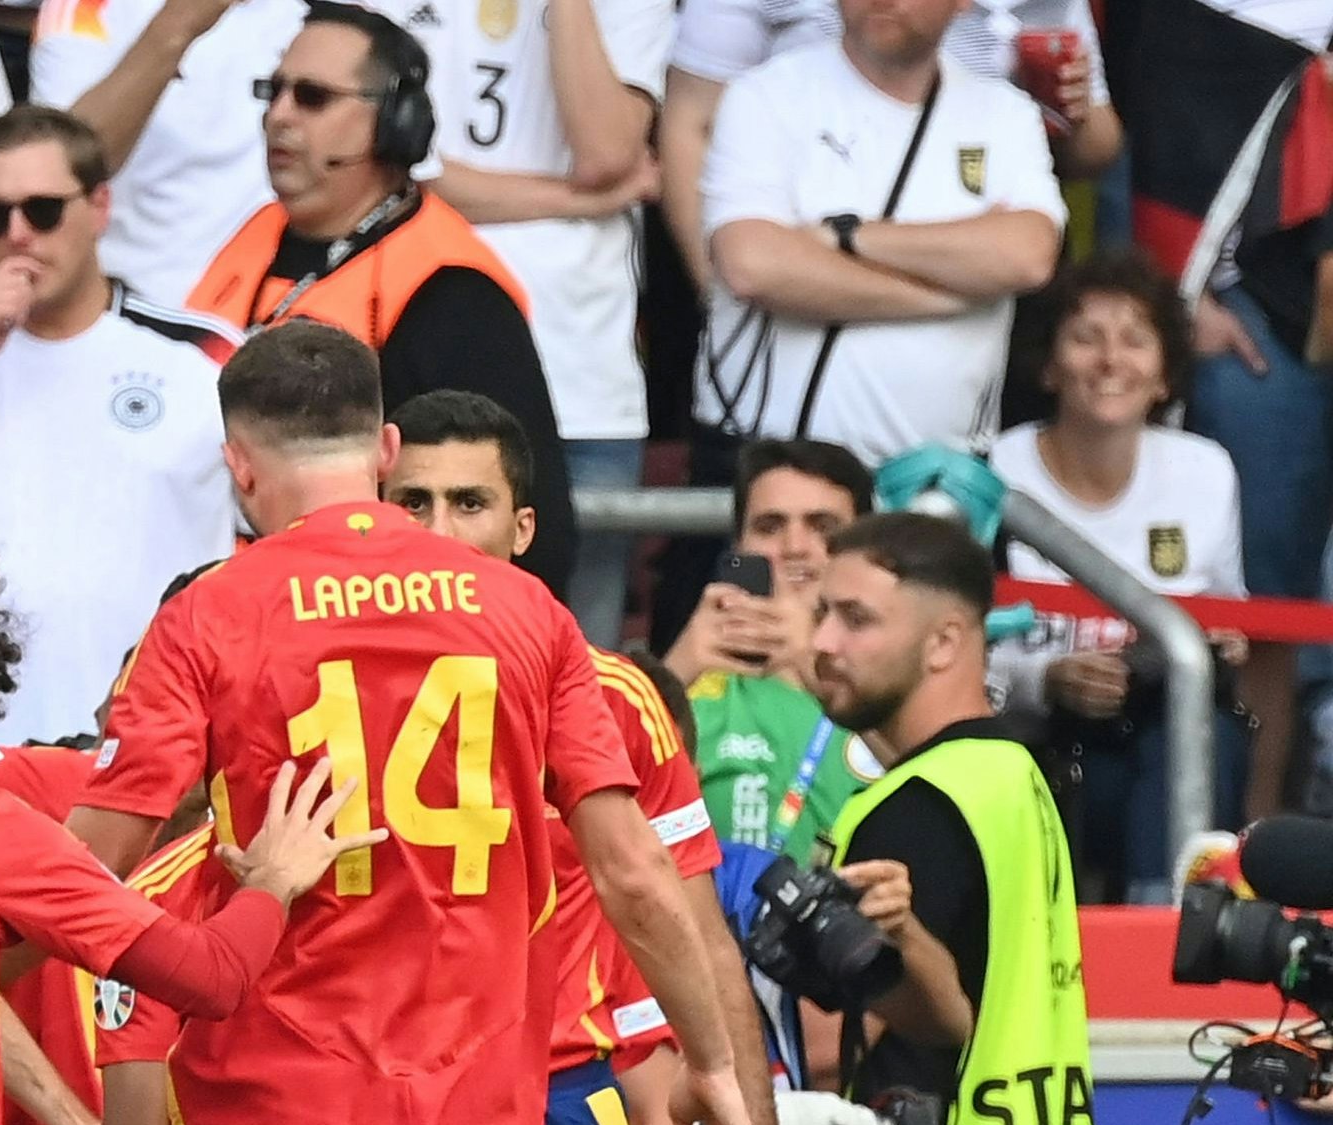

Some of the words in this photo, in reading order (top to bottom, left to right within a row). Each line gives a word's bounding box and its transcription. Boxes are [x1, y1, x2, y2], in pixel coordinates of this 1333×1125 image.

[468, 62, 508, 147] 3
[289, 571, 482, 623] LAPORTE
[288, 655, 511, 897] 14
